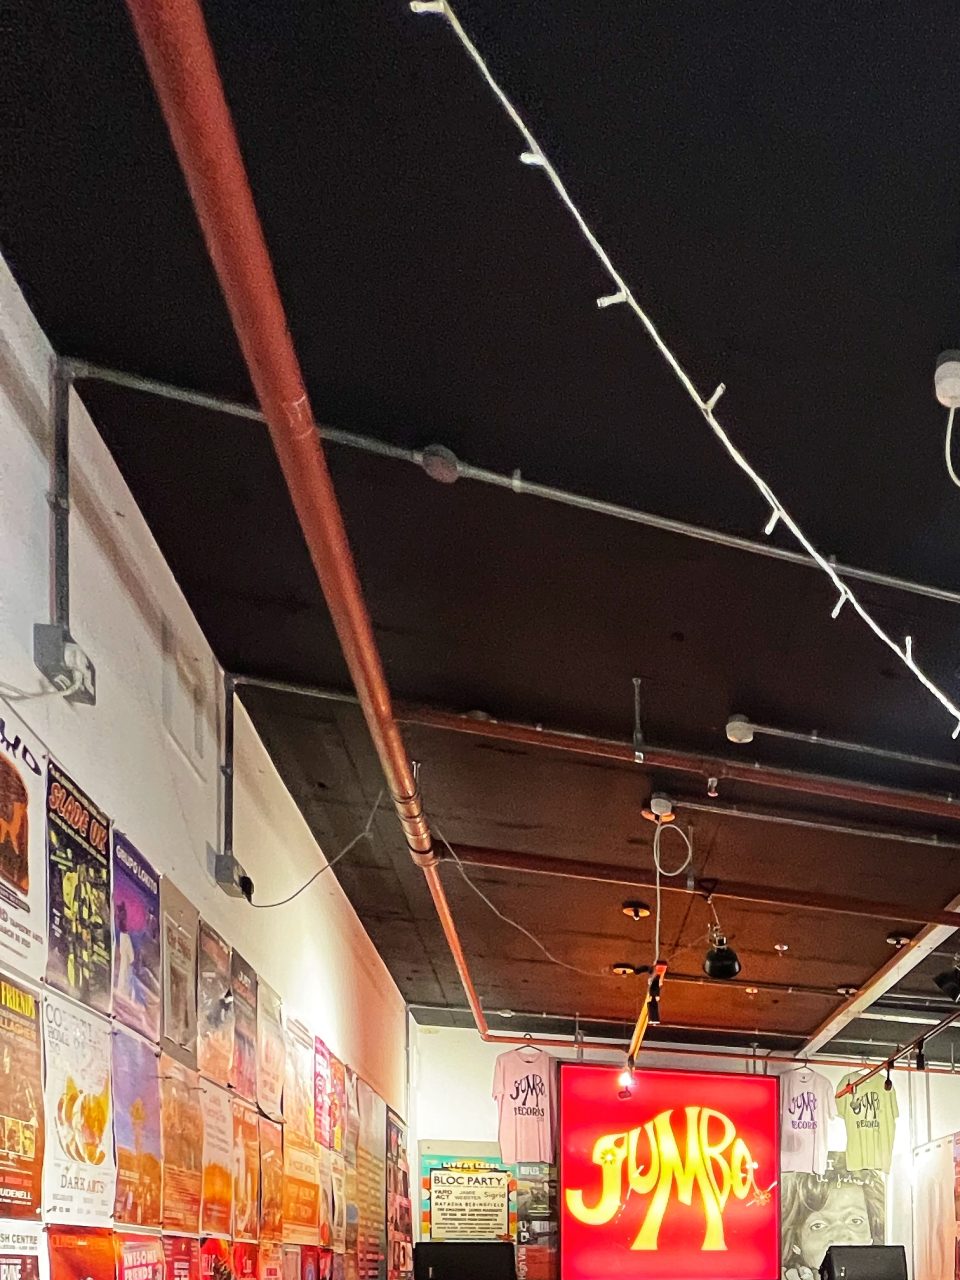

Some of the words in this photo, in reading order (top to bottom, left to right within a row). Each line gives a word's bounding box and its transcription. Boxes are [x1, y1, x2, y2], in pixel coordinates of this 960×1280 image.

[49, 783, 90, 837] SLADE
[89, 819, 109, 854] UK
[510, 1074, 546, 1106] JUMBO
[61, 1174, 85, 1191] DARK
[434, 1176, 464, 1185] BLOC
[565, 1106, 759, 1251] JUMBO
[484, 1191, 506, 1200] Sigrid
[12, 1234, 38, 1245] CENTRE
